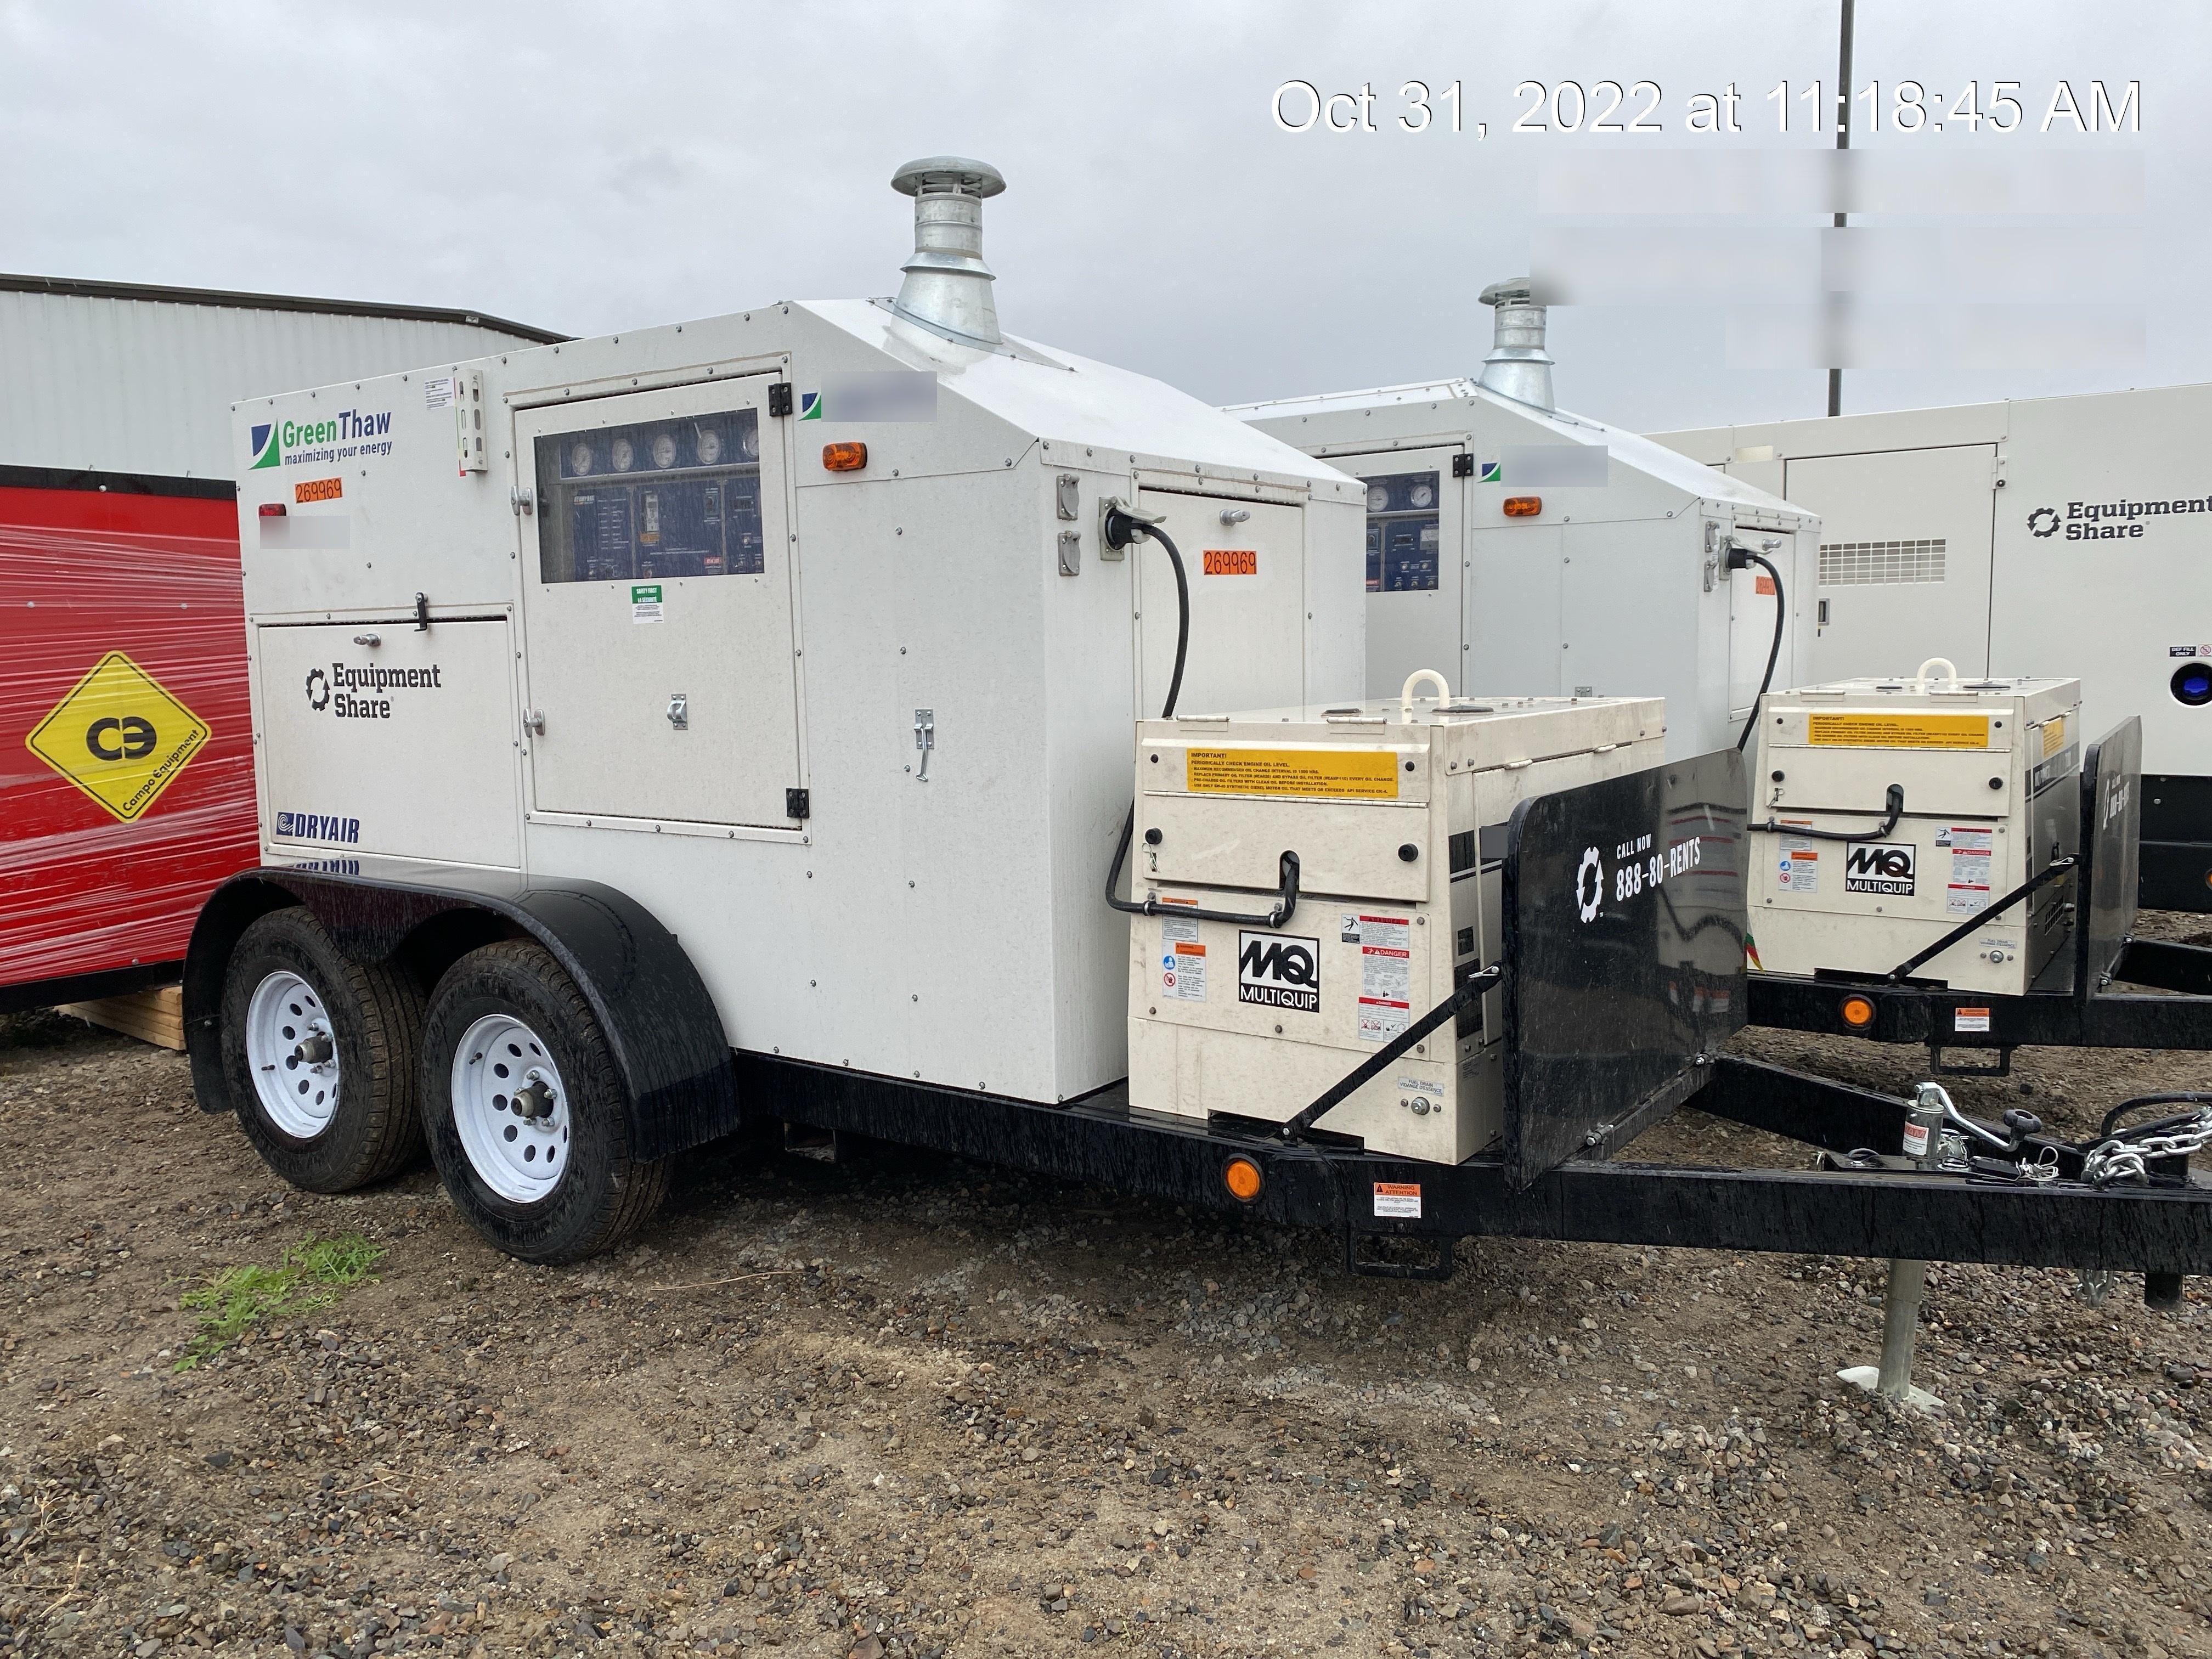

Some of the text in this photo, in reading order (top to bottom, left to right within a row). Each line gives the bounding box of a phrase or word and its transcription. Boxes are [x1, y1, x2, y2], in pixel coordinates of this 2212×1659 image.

[285, 441, 392, 466] maximizing your energy
[295, 478, 342, 504] 269969
[2066, 495, 2212, 521] Equipment
[2066, 522, 2144, 540] Share
[1204, 551, 1256, 574] 269969
[332, 662, 441, 693] Equipment
[334, 693, 391, 719] Share
[122, 729, 200, 811] Campo Equipment
[295, 813, 360, 844] DRYAIR
[1616, 833, 1651, 860] CALL NOW
[1616, 836, 1701, 901] 888-80-RENTS
[1847, 848, 1914, 879] MQ
[1847, 879, 1913, 894] MULTIQUIP
[1240, 940, 1317, 989] MQ
[1240, 985, 1317, 1009] MULTIQUIP
